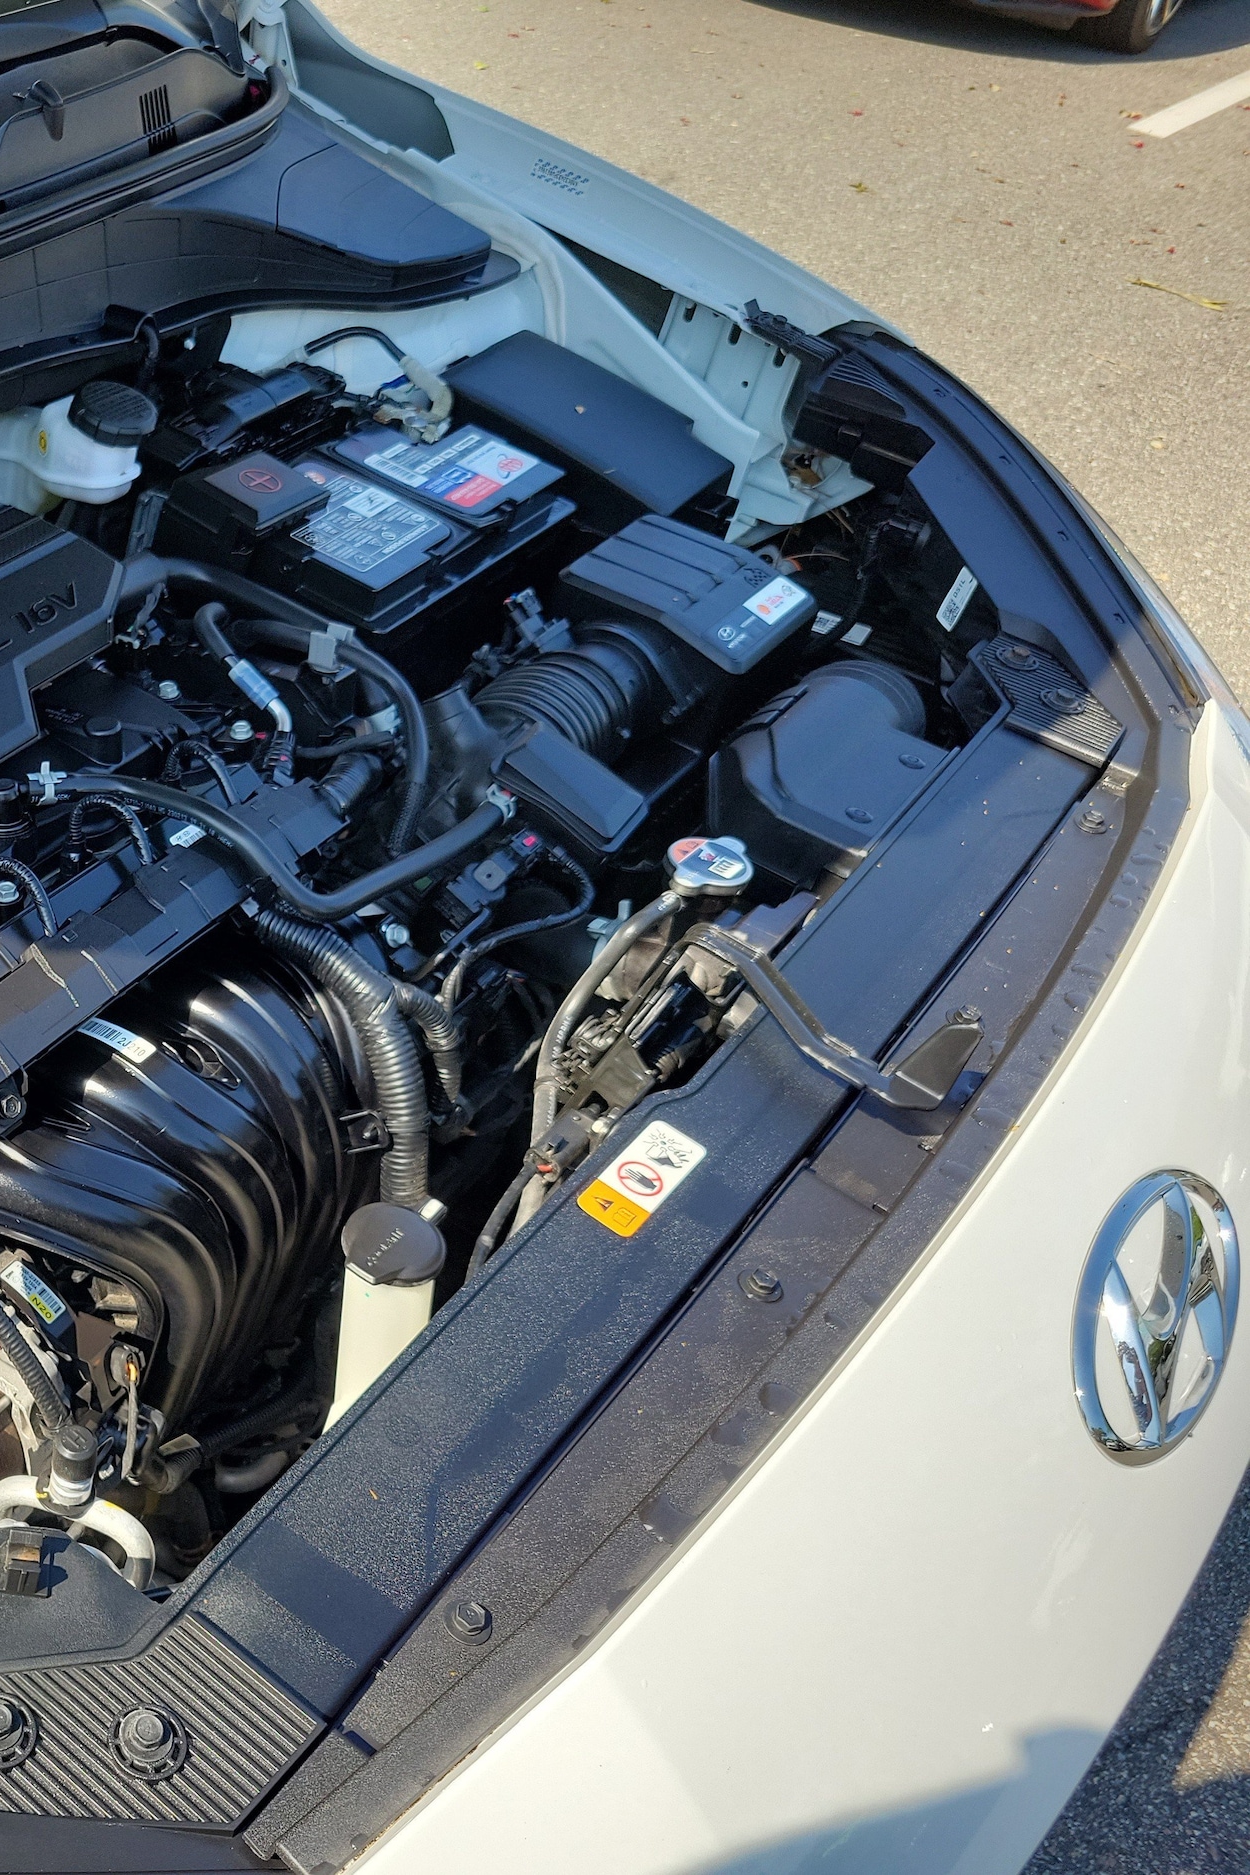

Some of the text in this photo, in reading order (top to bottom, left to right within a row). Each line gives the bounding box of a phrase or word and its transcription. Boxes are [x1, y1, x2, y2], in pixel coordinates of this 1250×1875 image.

[10, 580, 78, 634] 16V
[117, 1037, 147, 1057] 2J210
[32, 1297, 52, 1319] N20
